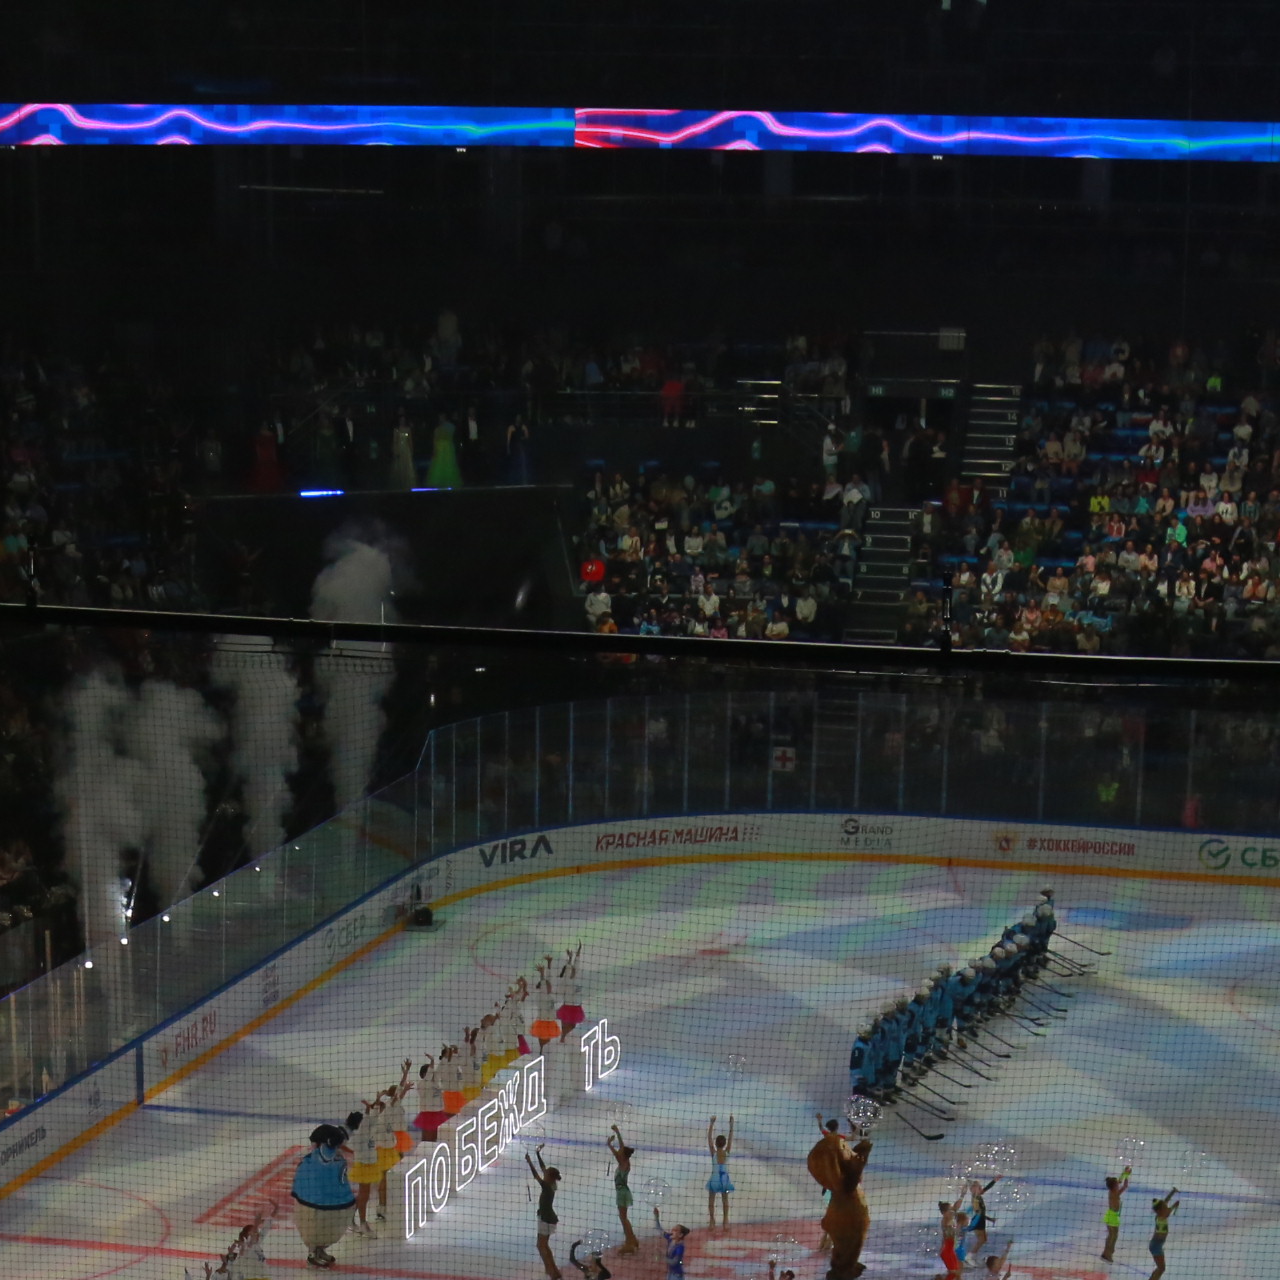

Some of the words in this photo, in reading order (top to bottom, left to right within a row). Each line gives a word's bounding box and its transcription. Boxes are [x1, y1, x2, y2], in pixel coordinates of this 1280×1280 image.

[478, 834, 554, 868] VIRA
[595, 830, 669, 851] КРАСНАЯ
[672, 826, 739, 844] МАШИНА
[1026, 836, 1136, 857] #ХОККЕЙРОССИИ
